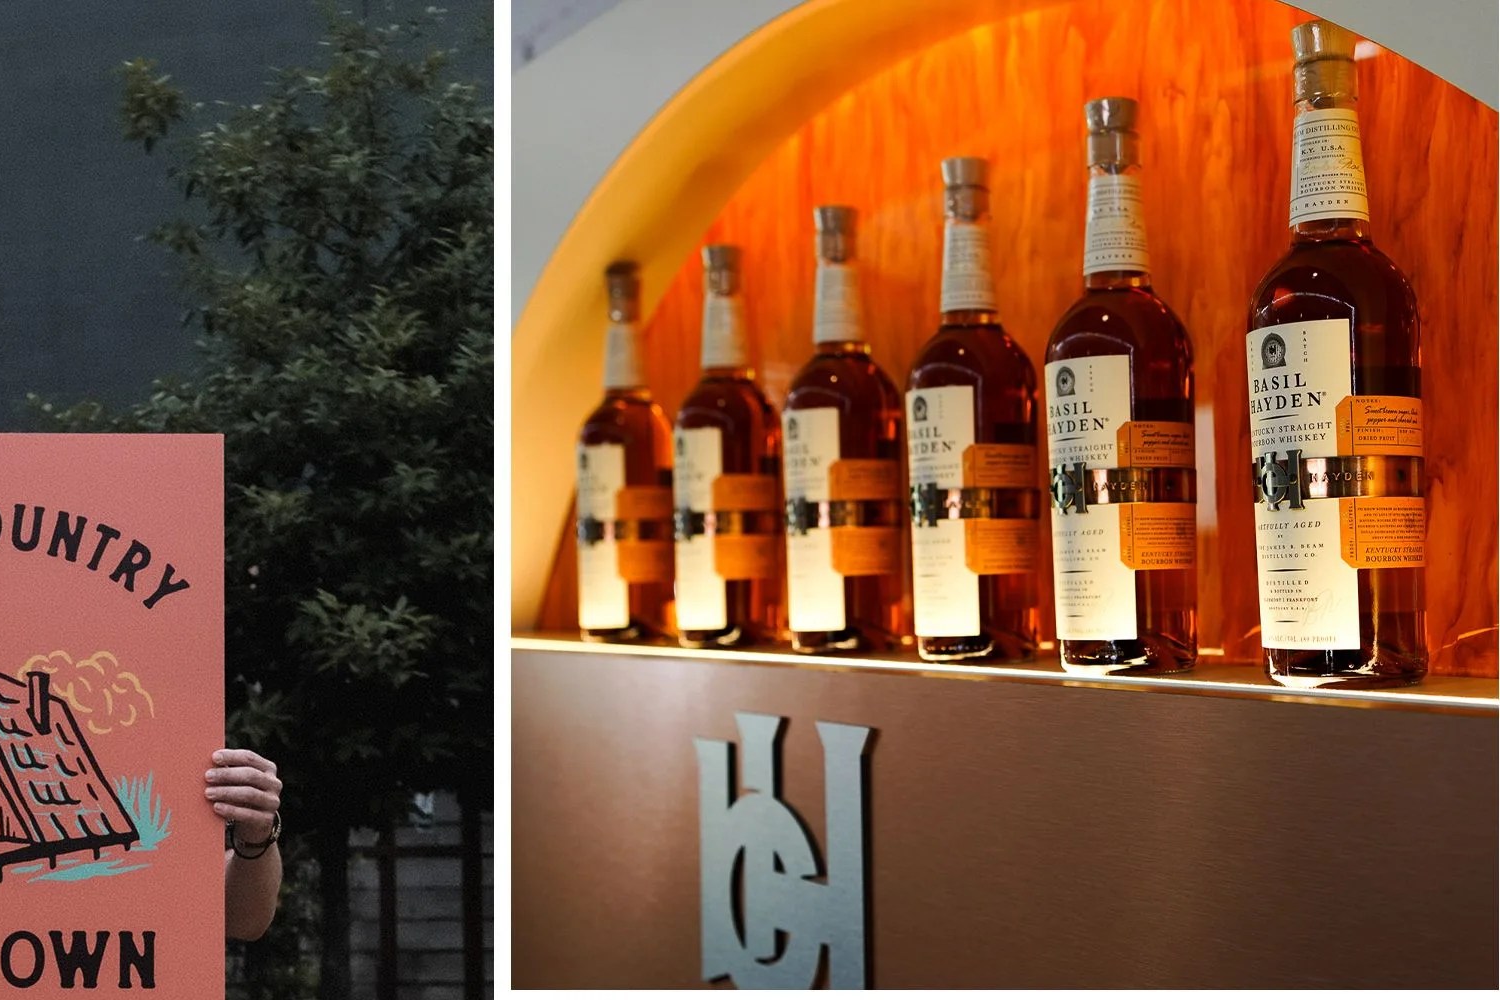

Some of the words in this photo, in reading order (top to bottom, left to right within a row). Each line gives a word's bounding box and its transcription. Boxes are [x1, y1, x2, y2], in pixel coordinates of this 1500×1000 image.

[1305, 124, 1352, 135] DISTILLING
[1301, 147, 1315, 155] K.Y.
[1321, 144, 1346, 152] U.S.A.
[1300, 185, 1336, 194] BOURBON
[1304, 199, 1349, 208] HAYDEN
[1254, 373, 1307, 393] BASIL
[1251, 391, 1322, 414] HAYDEN
[1278, 421, 1332, 432] STRAIGHT
[1279, 432, 1326, 444] WHISKEY
[1310, 471, 1375, 483] HAYDEN
[1293, 521, 1321, 529] AGED
[1365, 546, 1401, 554] KENTUCKY
